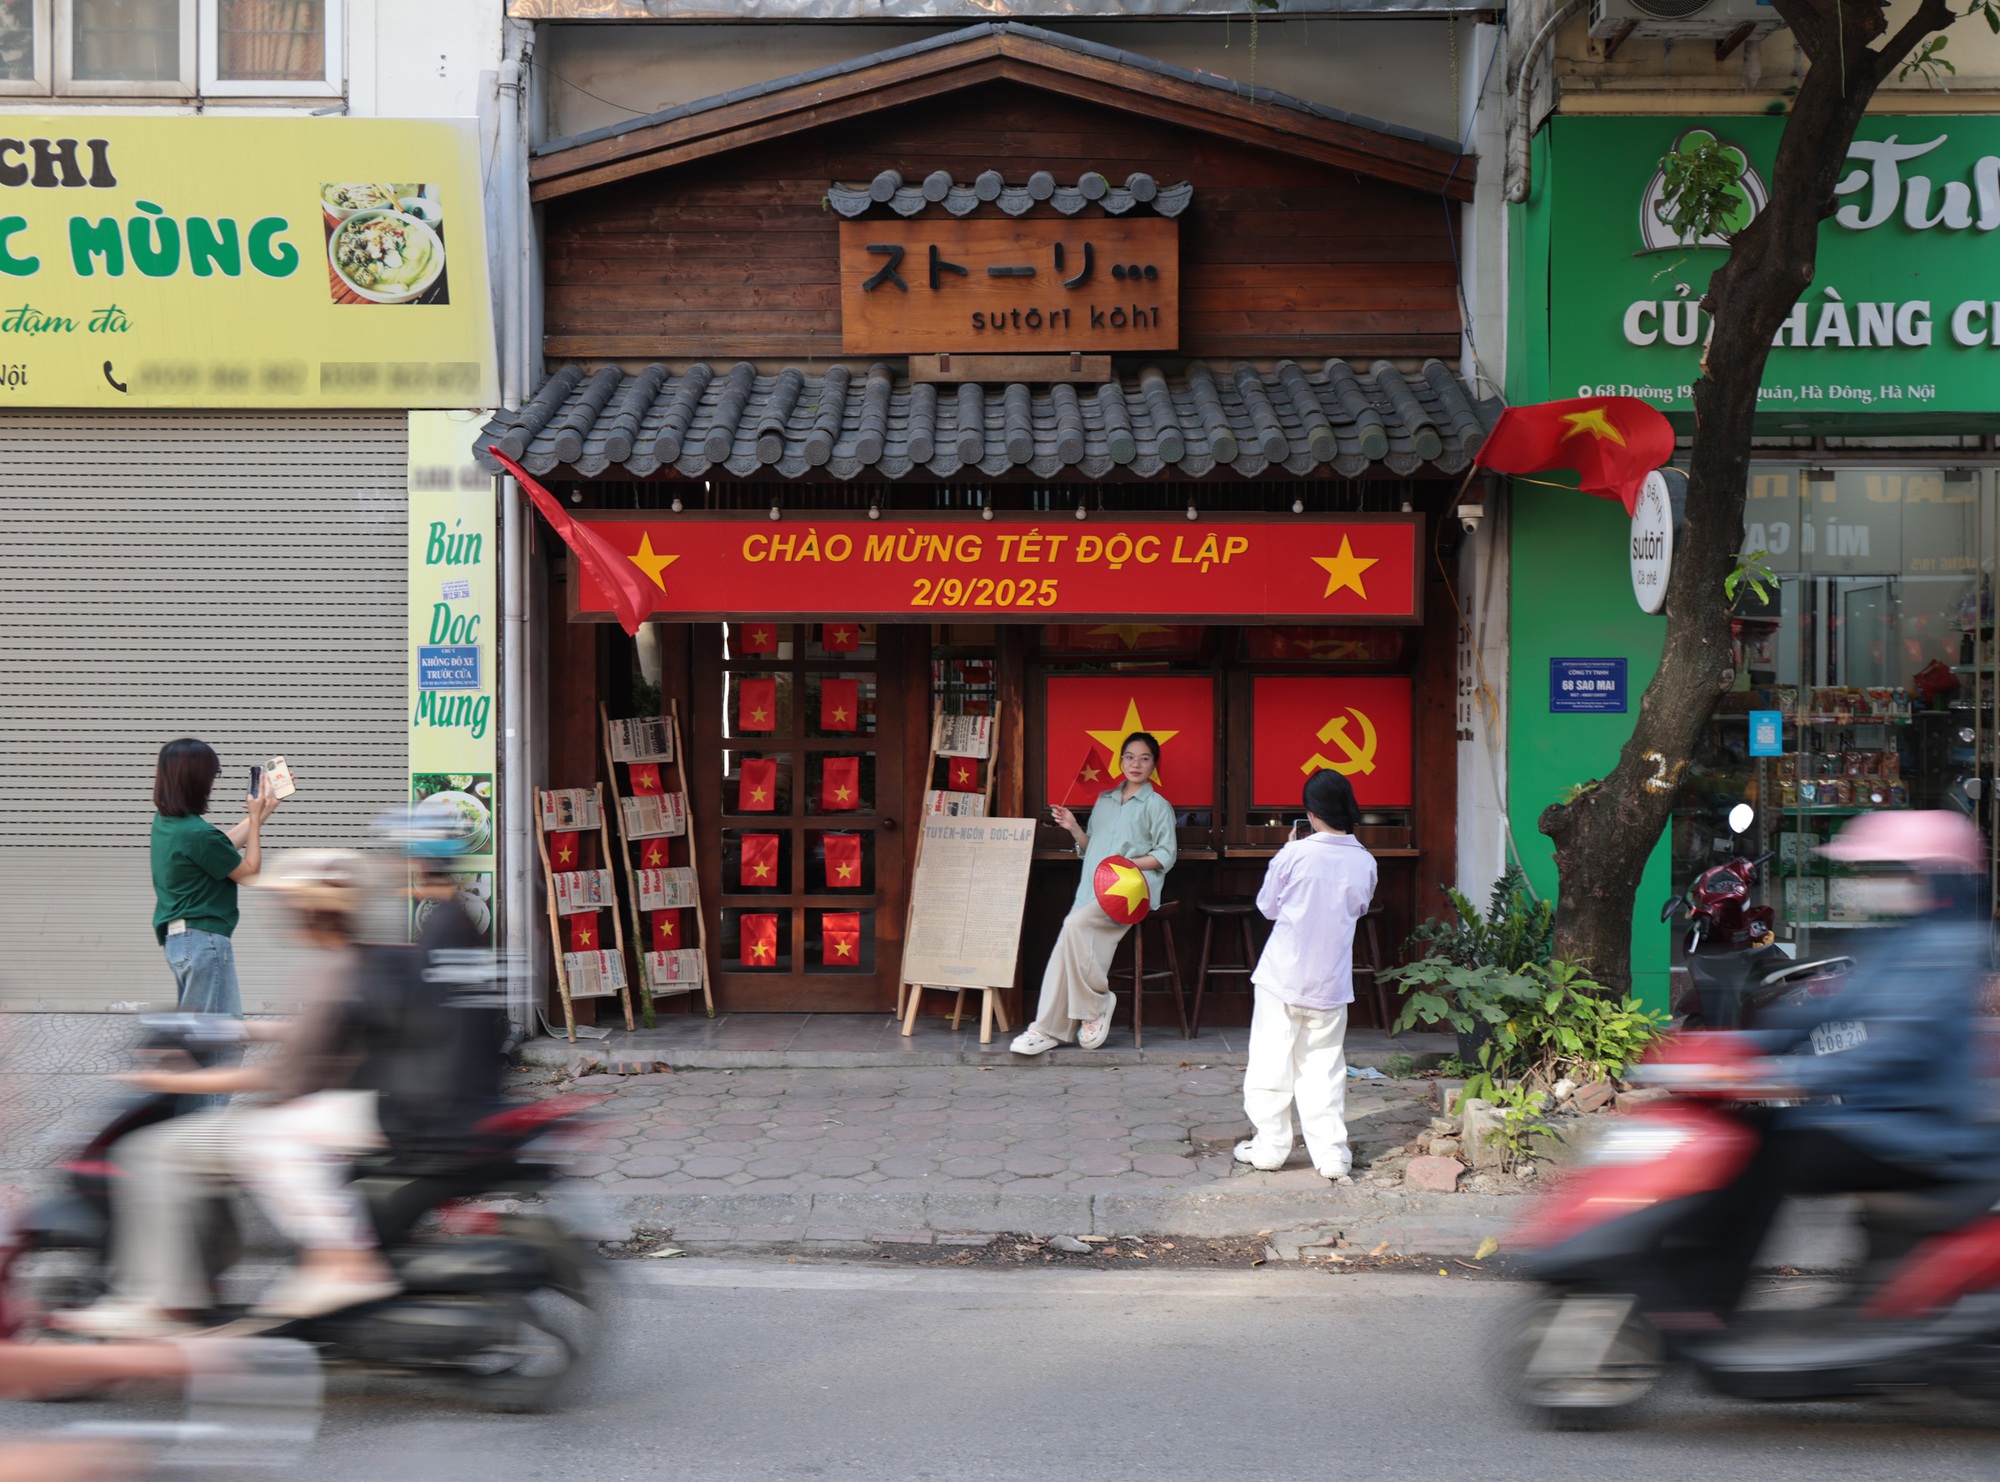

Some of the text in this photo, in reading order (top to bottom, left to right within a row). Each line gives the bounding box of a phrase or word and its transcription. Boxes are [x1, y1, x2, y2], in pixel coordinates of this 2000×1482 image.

[0, 138, 118, 187] CHI
[69, 201, 299, 277] MÙNG
[1, 304, 134, 336] đậm đà
[1952, 300, 2000, 347] C
[1619, 384, 1674, 404] Đường
[1801, 385, 1823, 399] Hà
[1828, 384, 1877, 405] Đông,
[1880, 385, 1902, 399] Hà
[1908, 384, 1936, 402] Nội
[425, 518, 483, 565] Bún
[742, 527, 1249, 573] CHÀO MỪNG TẾT ĐỘC LẬP
[911, 578, 1059, 607] 2/9/2025
[1562, 680, 1616, 691] 68 SAO MAI
